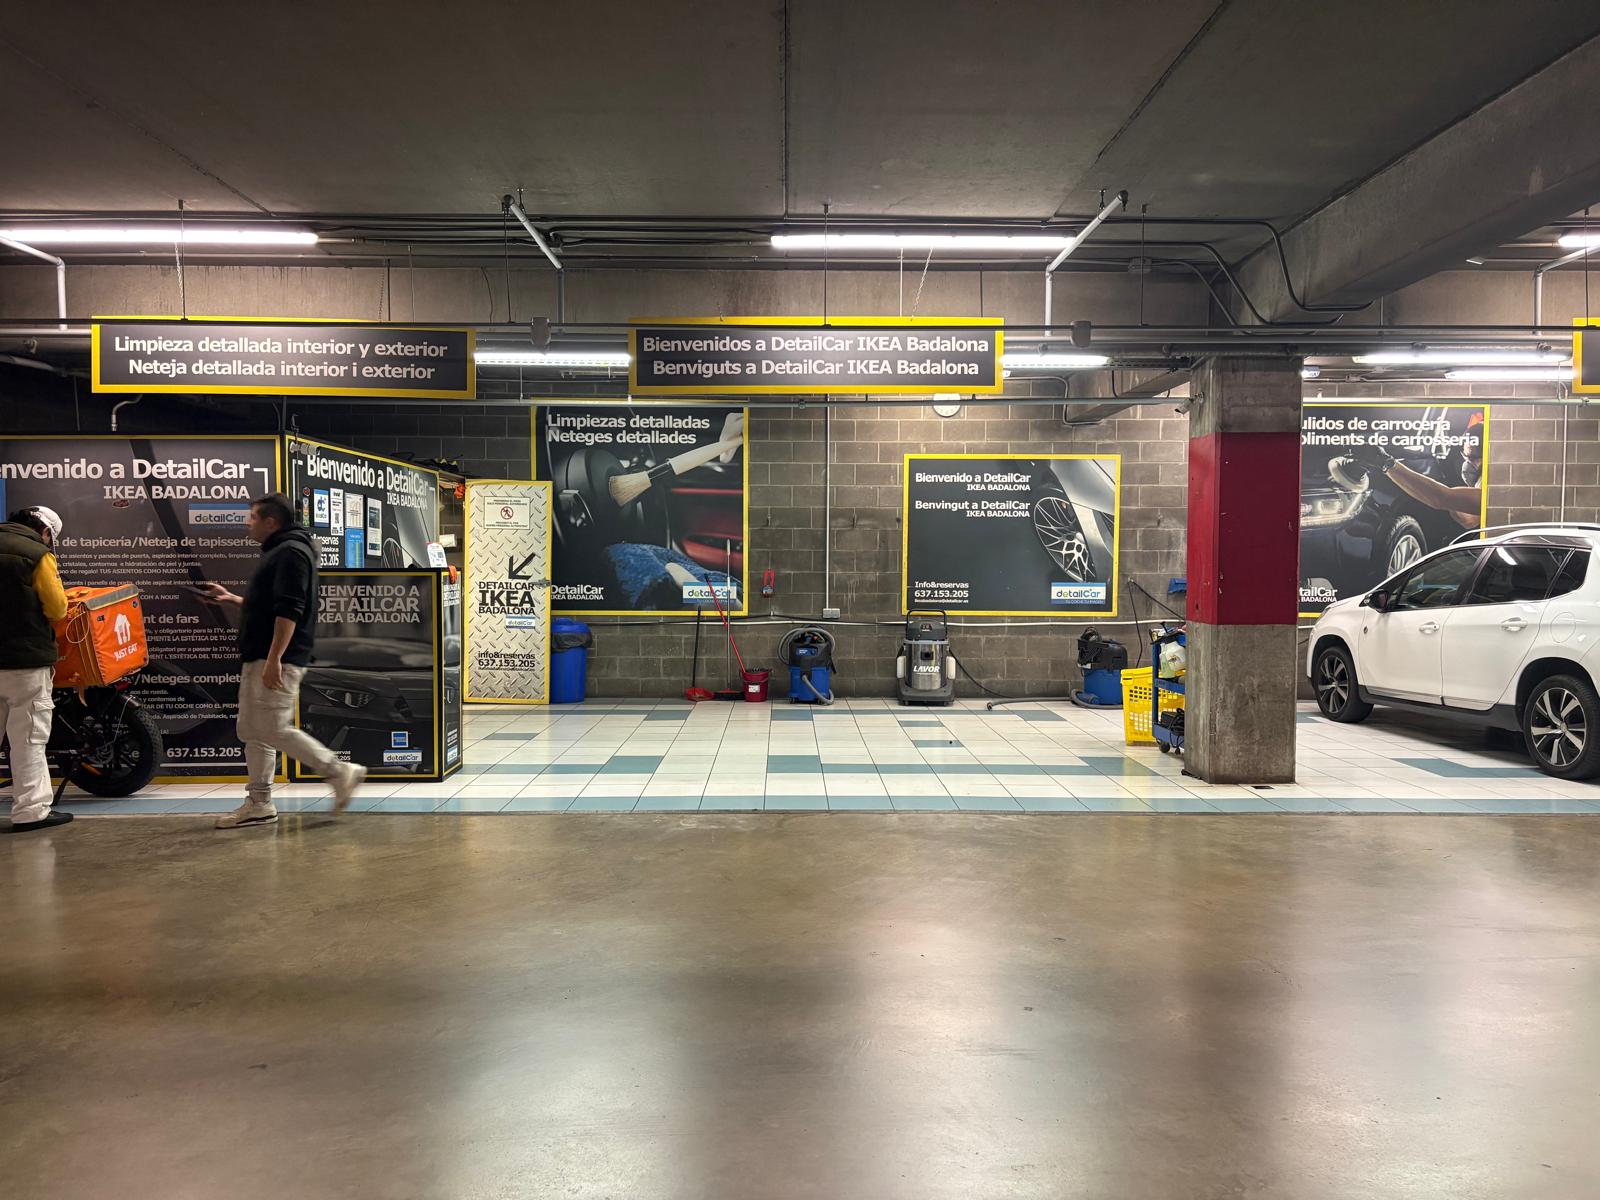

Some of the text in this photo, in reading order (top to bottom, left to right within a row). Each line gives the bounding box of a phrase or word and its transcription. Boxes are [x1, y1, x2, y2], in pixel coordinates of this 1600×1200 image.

[115, 336, 448, 358] Limpieza detallada interior y exterior
[643, 336, 989, 352] Bienvenidos a DetailCar IKEA Badalona
[129, 359, 435, 379] Neteja detallada interior i exterior
[653, 359, 979, 378] Benviguts a DetailCar IKEA Badalona
[547, 414, 710, 430] Limpiezas detalladas
[1347, 417, 1368, 430] de
[547, 429, 696, 445] Neteges detallades
[1368, 432, 1388, 445] de
[1392, 432, 1480, 446] carrosseria
[0, 458, 250, 479] nvenido a DetailCar
[307, 454, 429, 496] Bienvenido a DetailCar
[915, 473, 1031, 483] Bienvenido a DetailCar
[103, 485, 250, 499] IKEA BADALONA
[386, 492, 428, 510] IKEA BADALONA
[915, 500, 969, 512] Benvingut
[981, 500, 1030, 510] DetailCar
[195, 512, 246, 522] detailCar
[62, 537, 78, 547] de
[180, 537, 196, 547] de
[408, 585, 420, 597] A
[479, 581, 535, 590] DETAILCAR
[479, 590, 536, 607] IKEA
[914, 590, 969, 598] 637.153.205
[1056, 588, 1101, 598] detailCar
[479, 606, 536, 615] BADALONA
[158, 614, 174, 624] de
[176, 613, 200, 624] fars
[346, 612, 420, 623] BADALONA
[114, 643, 138, 661] JUST EAT
[478, 651, 536, 659] info&reservas
[478, 659, 536, 668] 637.153.205
[913, 665, 940, 673] LAVOR
[166, 747, 242, 758] 637.153.205
